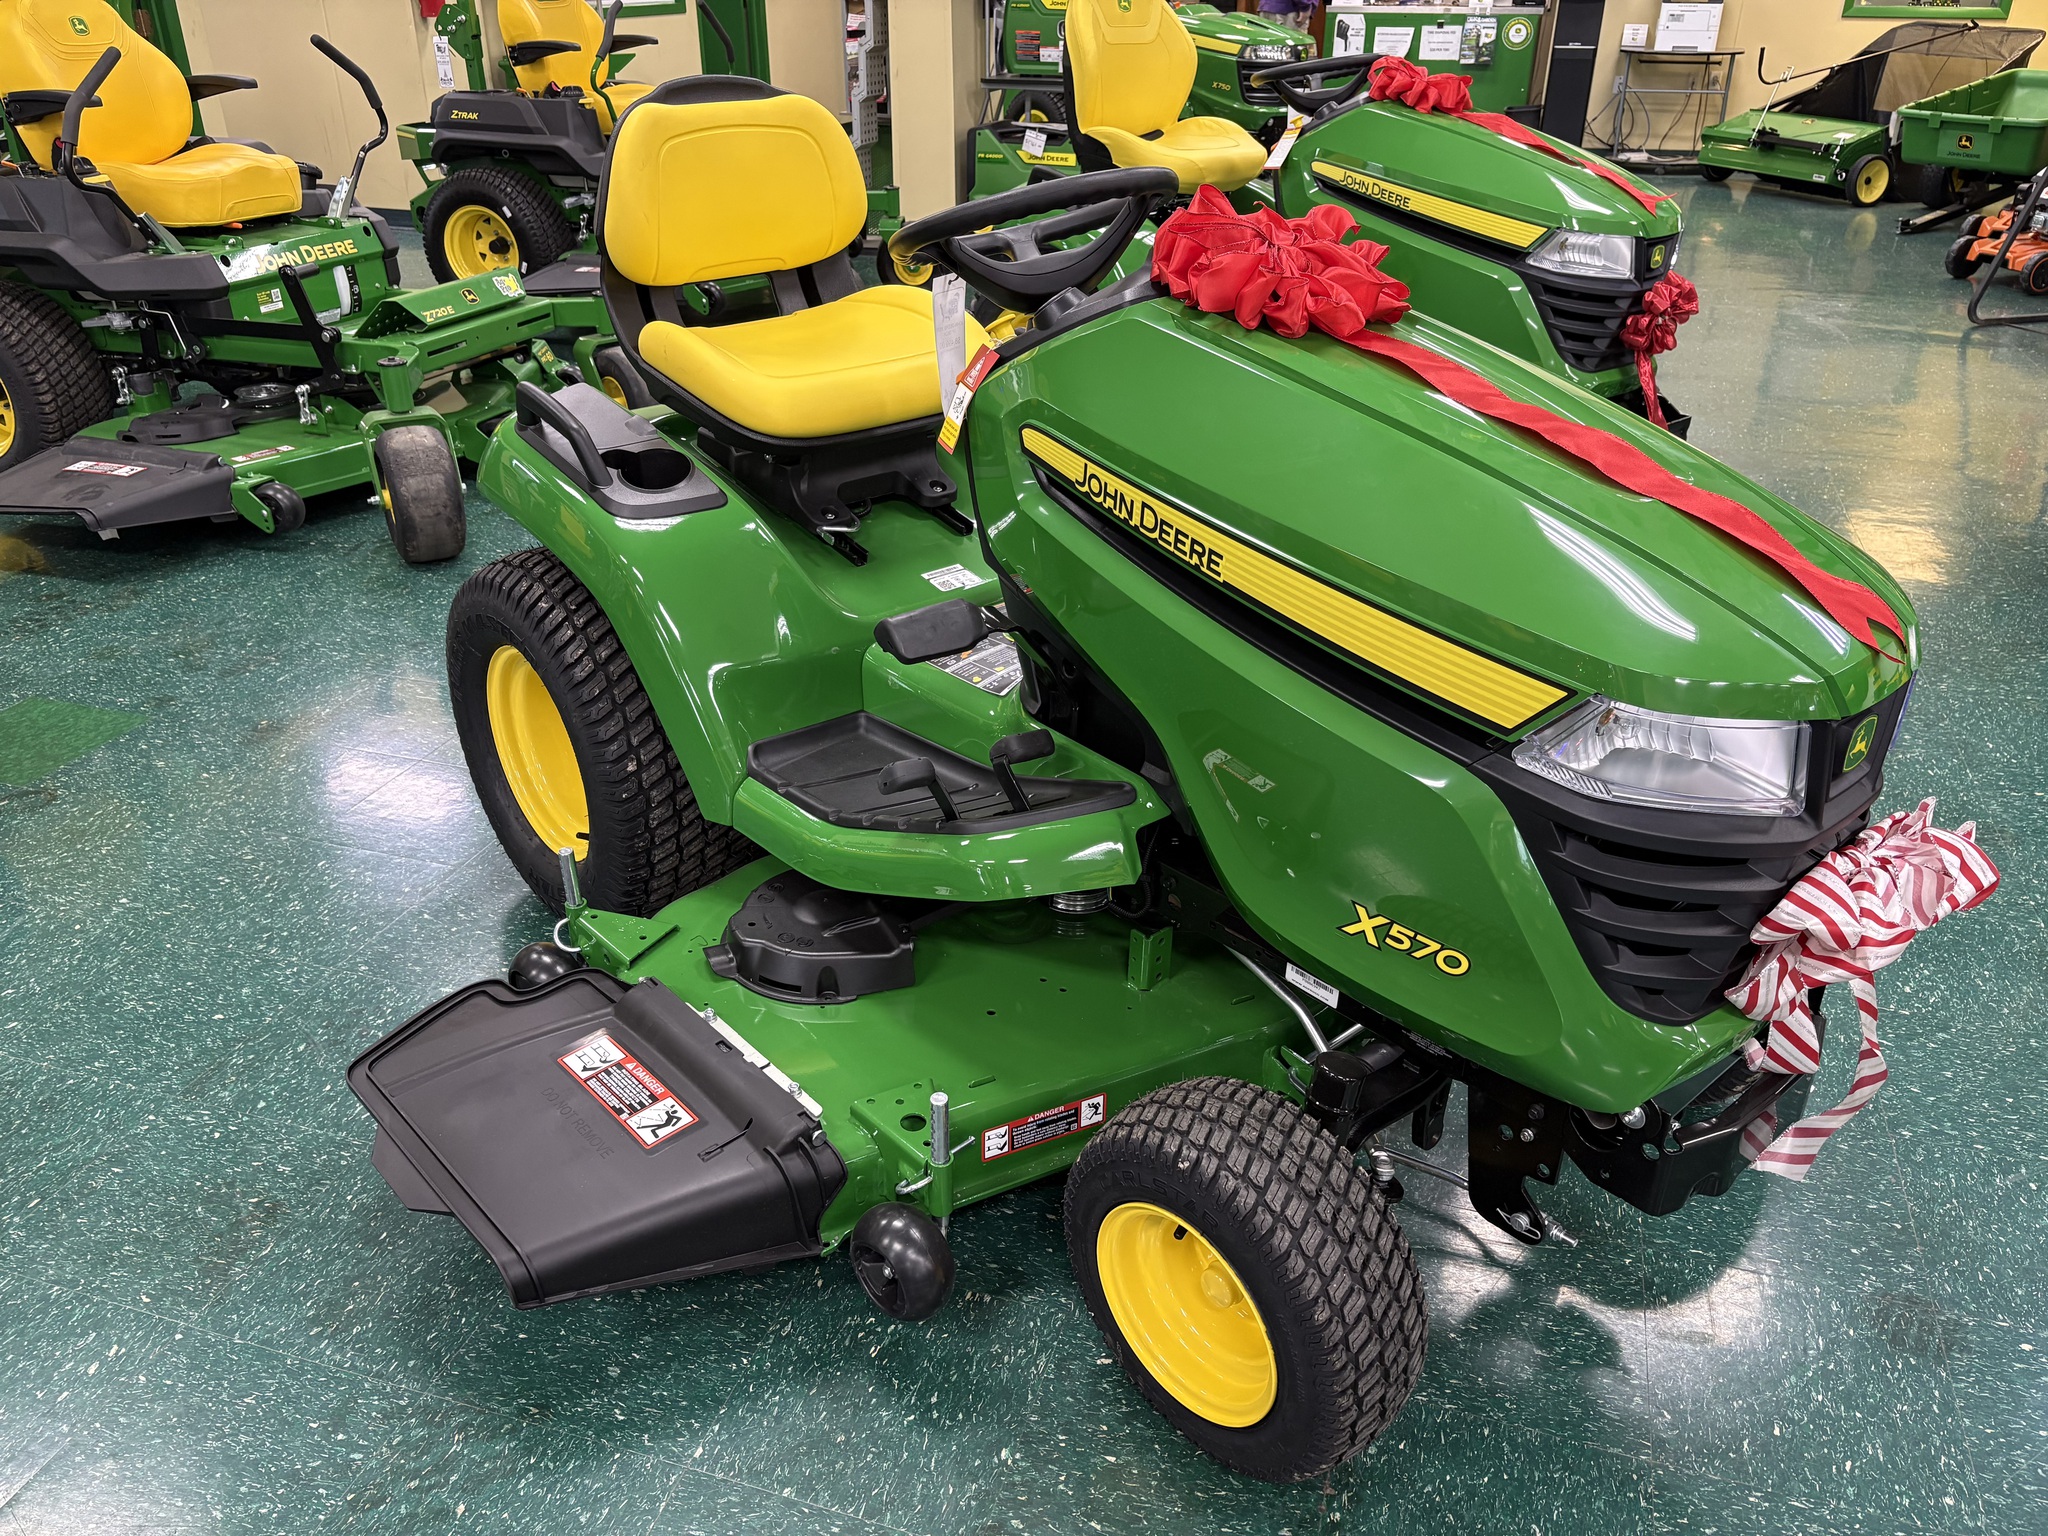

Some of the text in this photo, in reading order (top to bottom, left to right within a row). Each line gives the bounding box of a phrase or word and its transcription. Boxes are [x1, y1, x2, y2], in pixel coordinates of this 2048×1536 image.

[1211, 82, 1231, 91] X750
[450, 109, 479, 120] ZTRAK
[1338, 170, 1411, 208] JOHN DEERE
[256, 239, 358, 274] JOHN DEERE
[1075, 462, 1224, 578] JOHN DEERE
[1337, 902, 1471, 976] X570
[633, 1066, 665, 1095] DANGER
[553, 1099, 580, 1121] NOT
[569, 1117, 616, 1159] REMOVE
[1034, 1105, 1065, 1120] DANGER
